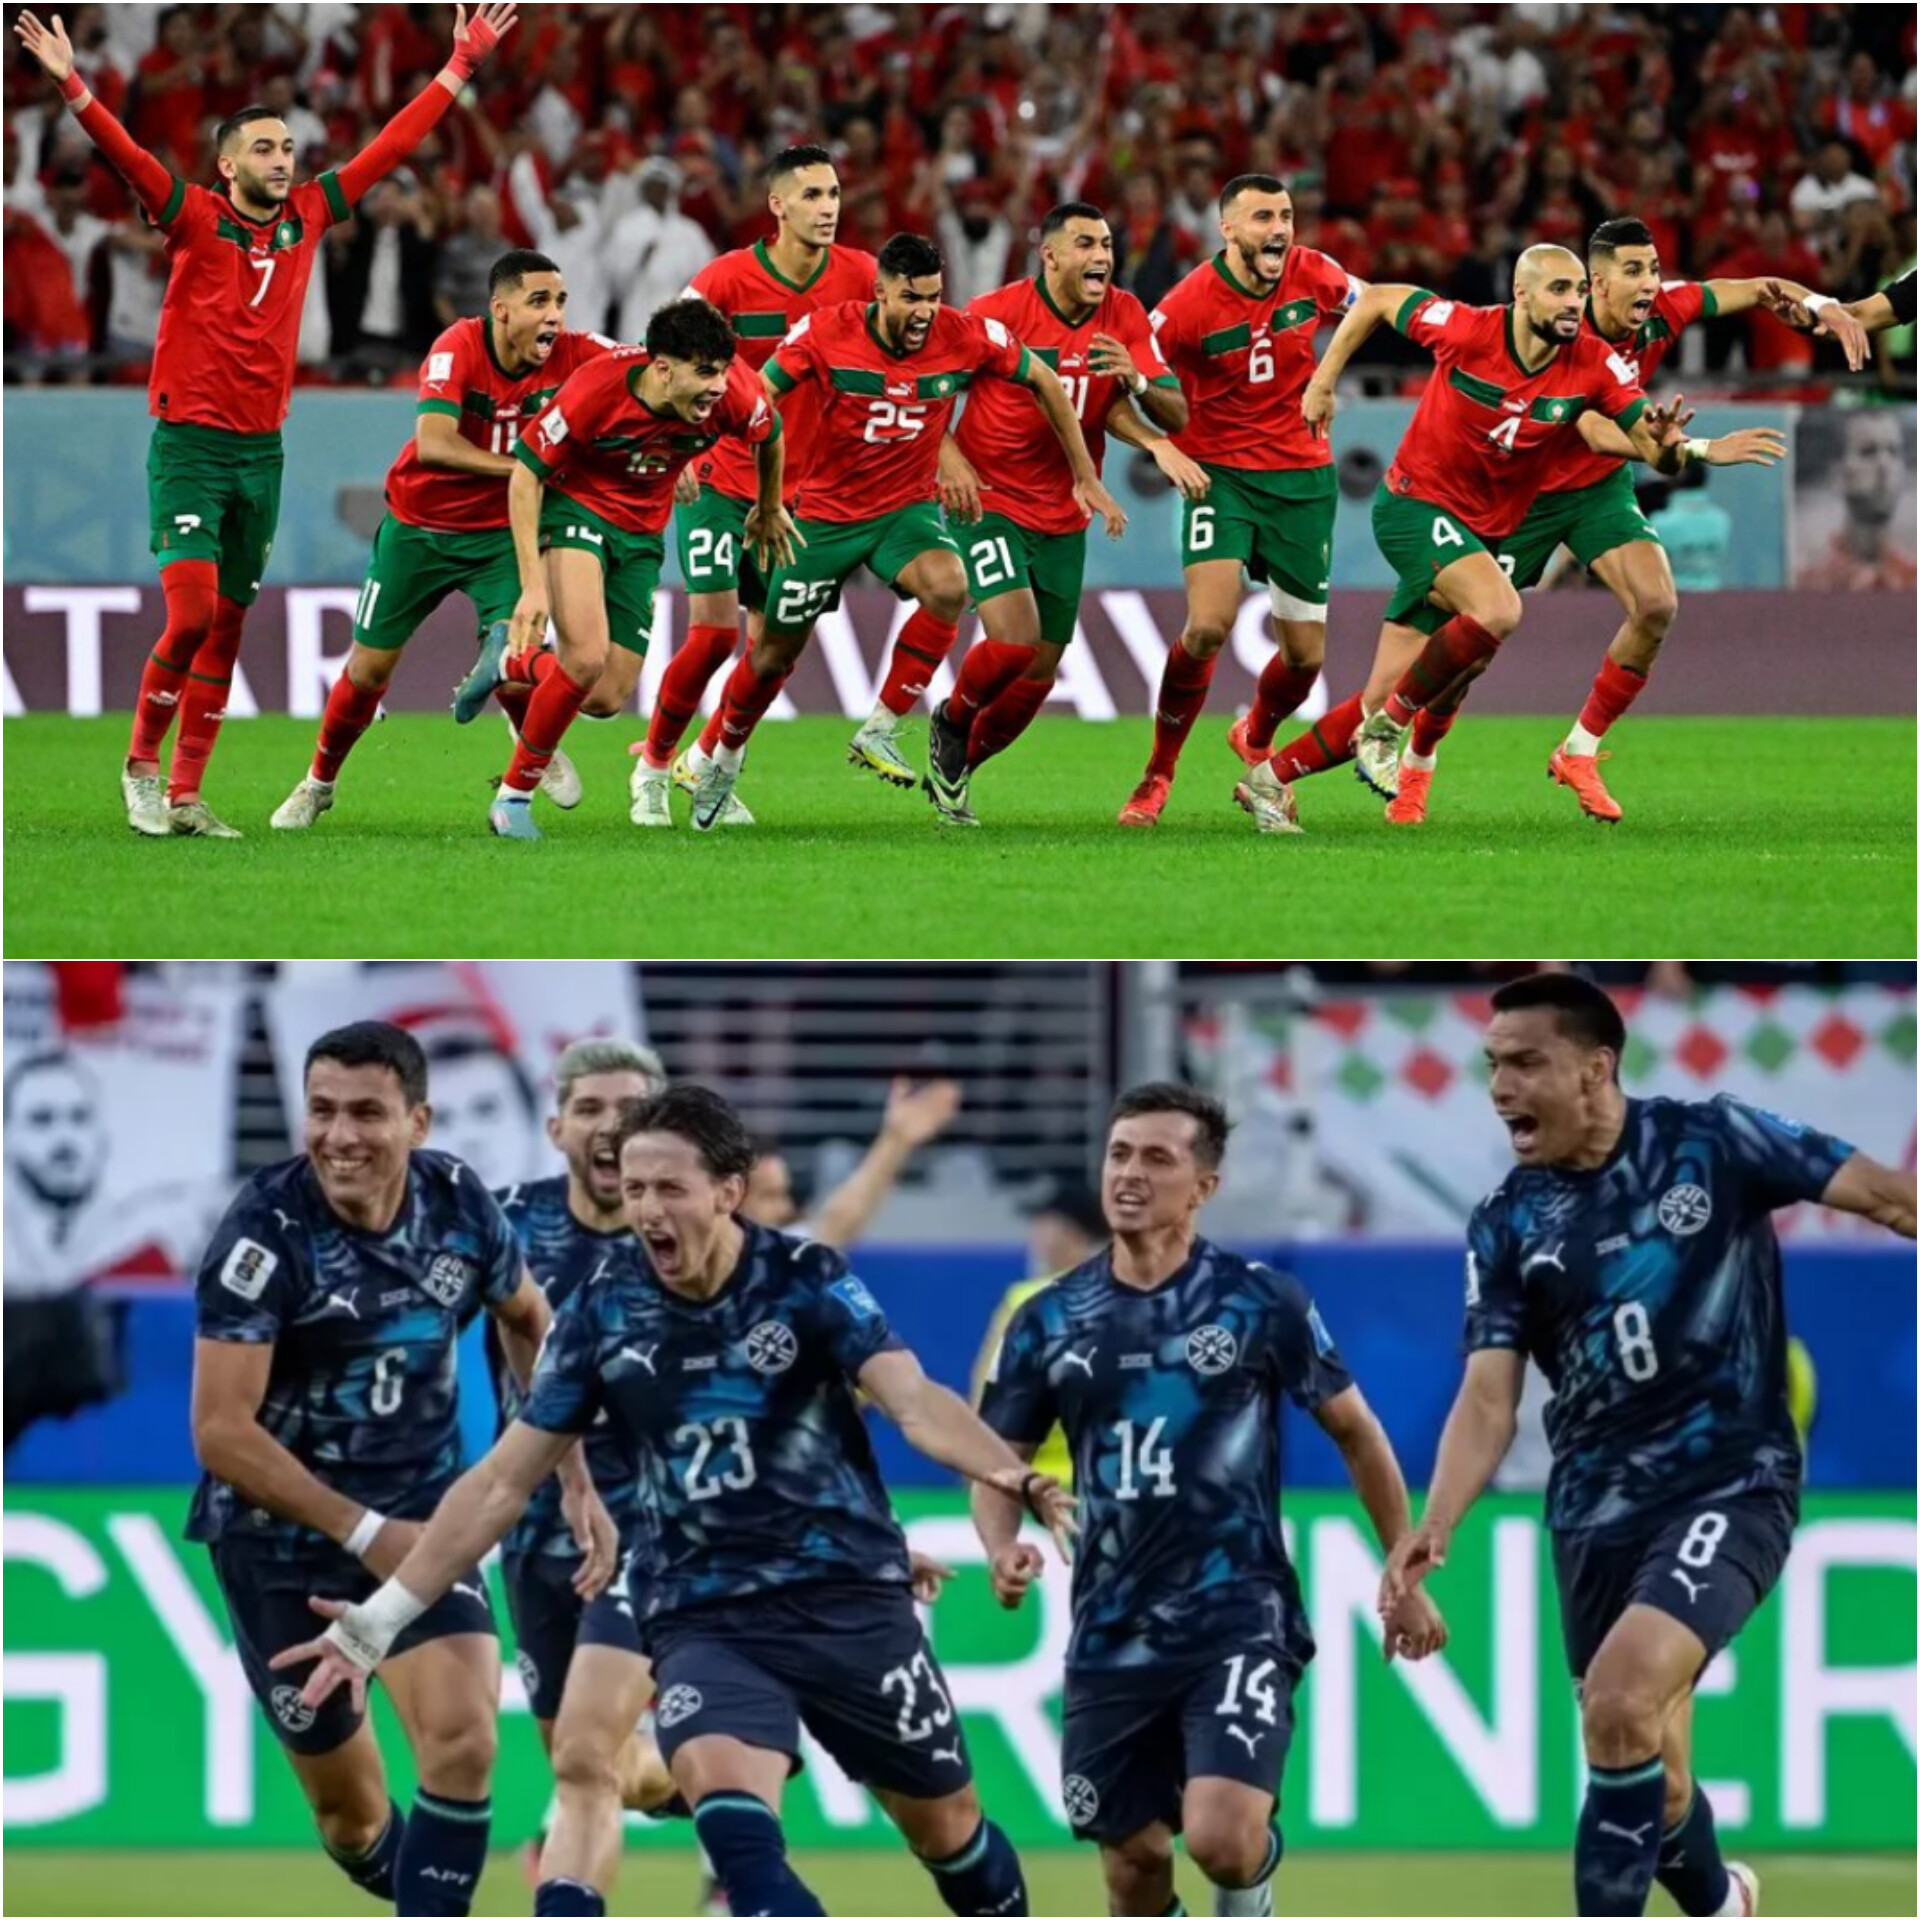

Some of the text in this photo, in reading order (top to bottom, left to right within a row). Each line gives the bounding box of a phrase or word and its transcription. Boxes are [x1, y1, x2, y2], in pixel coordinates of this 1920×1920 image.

[249, 258, 276, 307] 7
[1249, 338, 1275, 384] 6
[864, 401, 927, 443] 25
[688, 528, 734, 577] 24
[1189, 505, 1216, 552] 6
[1431, 516, 1465, 547] 4
[969, 536, 1017, 588] 21
[776, 579, 837, 623] 25
[1613, 1300, 1659, 1382] 8
[371, 1346, 408, 1416] 6
[674, 1416, 757, 1501] 23
[1111, 1415, 1177, 1501] 14
[1677, 1510, 1729, 1568] 8
[881, 1649, 951, 1742] 23
[1214, 1653, 1278, 1727] 14
